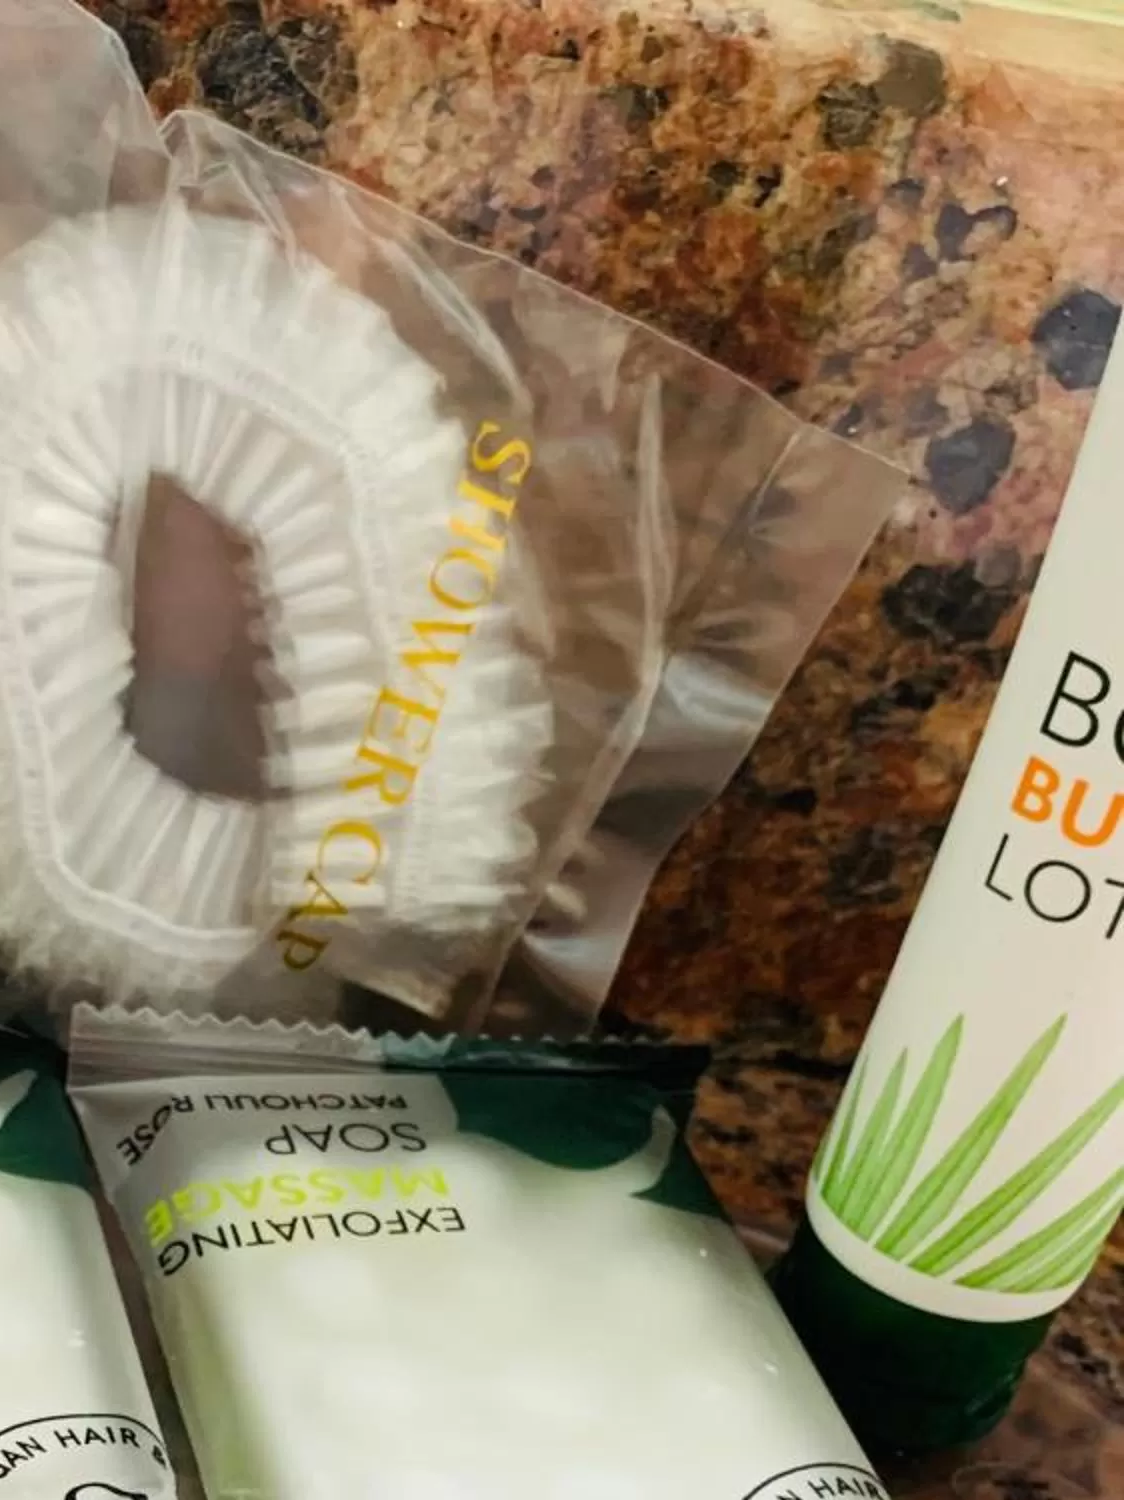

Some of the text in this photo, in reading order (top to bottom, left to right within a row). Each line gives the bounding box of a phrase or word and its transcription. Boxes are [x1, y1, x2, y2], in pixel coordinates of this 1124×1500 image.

[276, 420, 533, 972] SHOWER CAP
[1040, 650, 1124, 766] B
[205, 1093, 408, 1112] PATCHOULI
[264, 1123, 427, 1156] SOAP
[144, 1167, 451, 1247] MASSAGE
[157, 1207, 466, 1277] EXFOLIATING
[54, 1426, 140, 1449] HAIR
